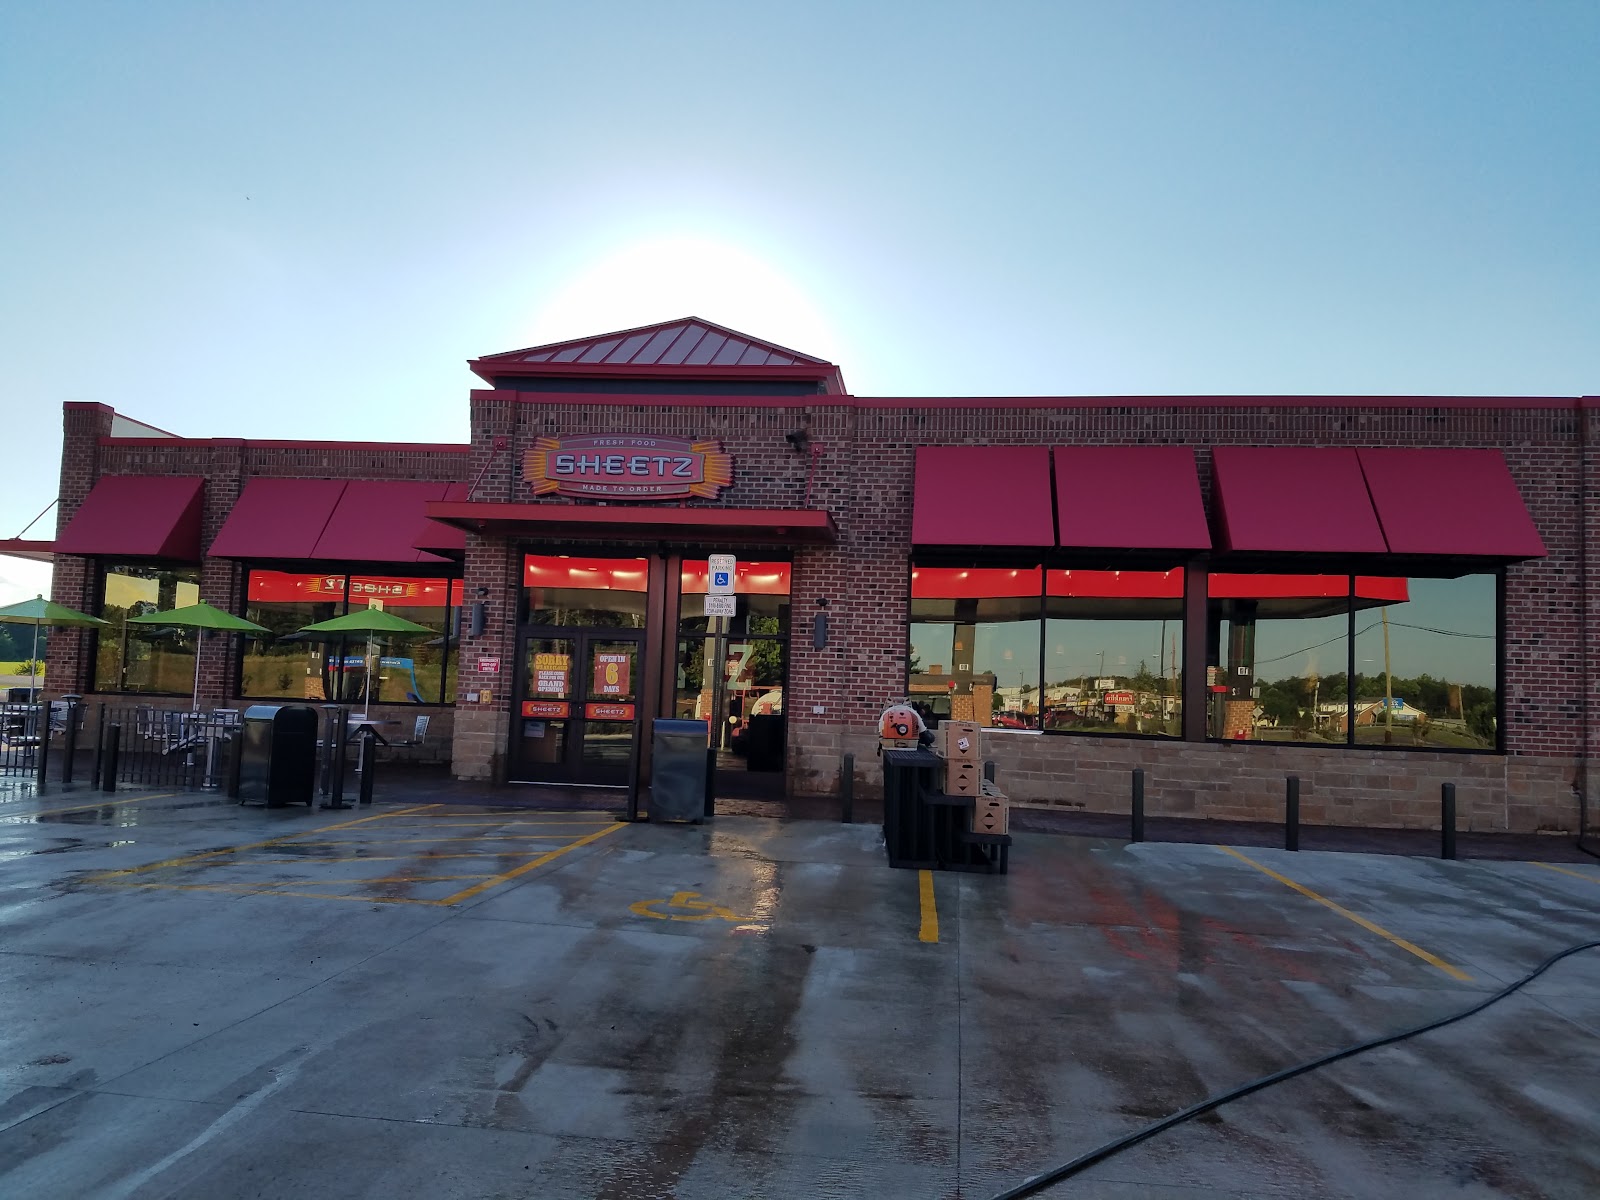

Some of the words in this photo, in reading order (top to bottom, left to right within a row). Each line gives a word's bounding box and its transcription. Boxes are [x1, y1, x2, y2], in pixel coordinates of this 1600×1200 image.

[631, 439, 656, 447] FOOD
[555, 454, 693, 477] SHEETZ
[582, 484, 608, 492] MADE
[535, 655, 569, 665] SORRY
[606, 663, 619, 685] 6
